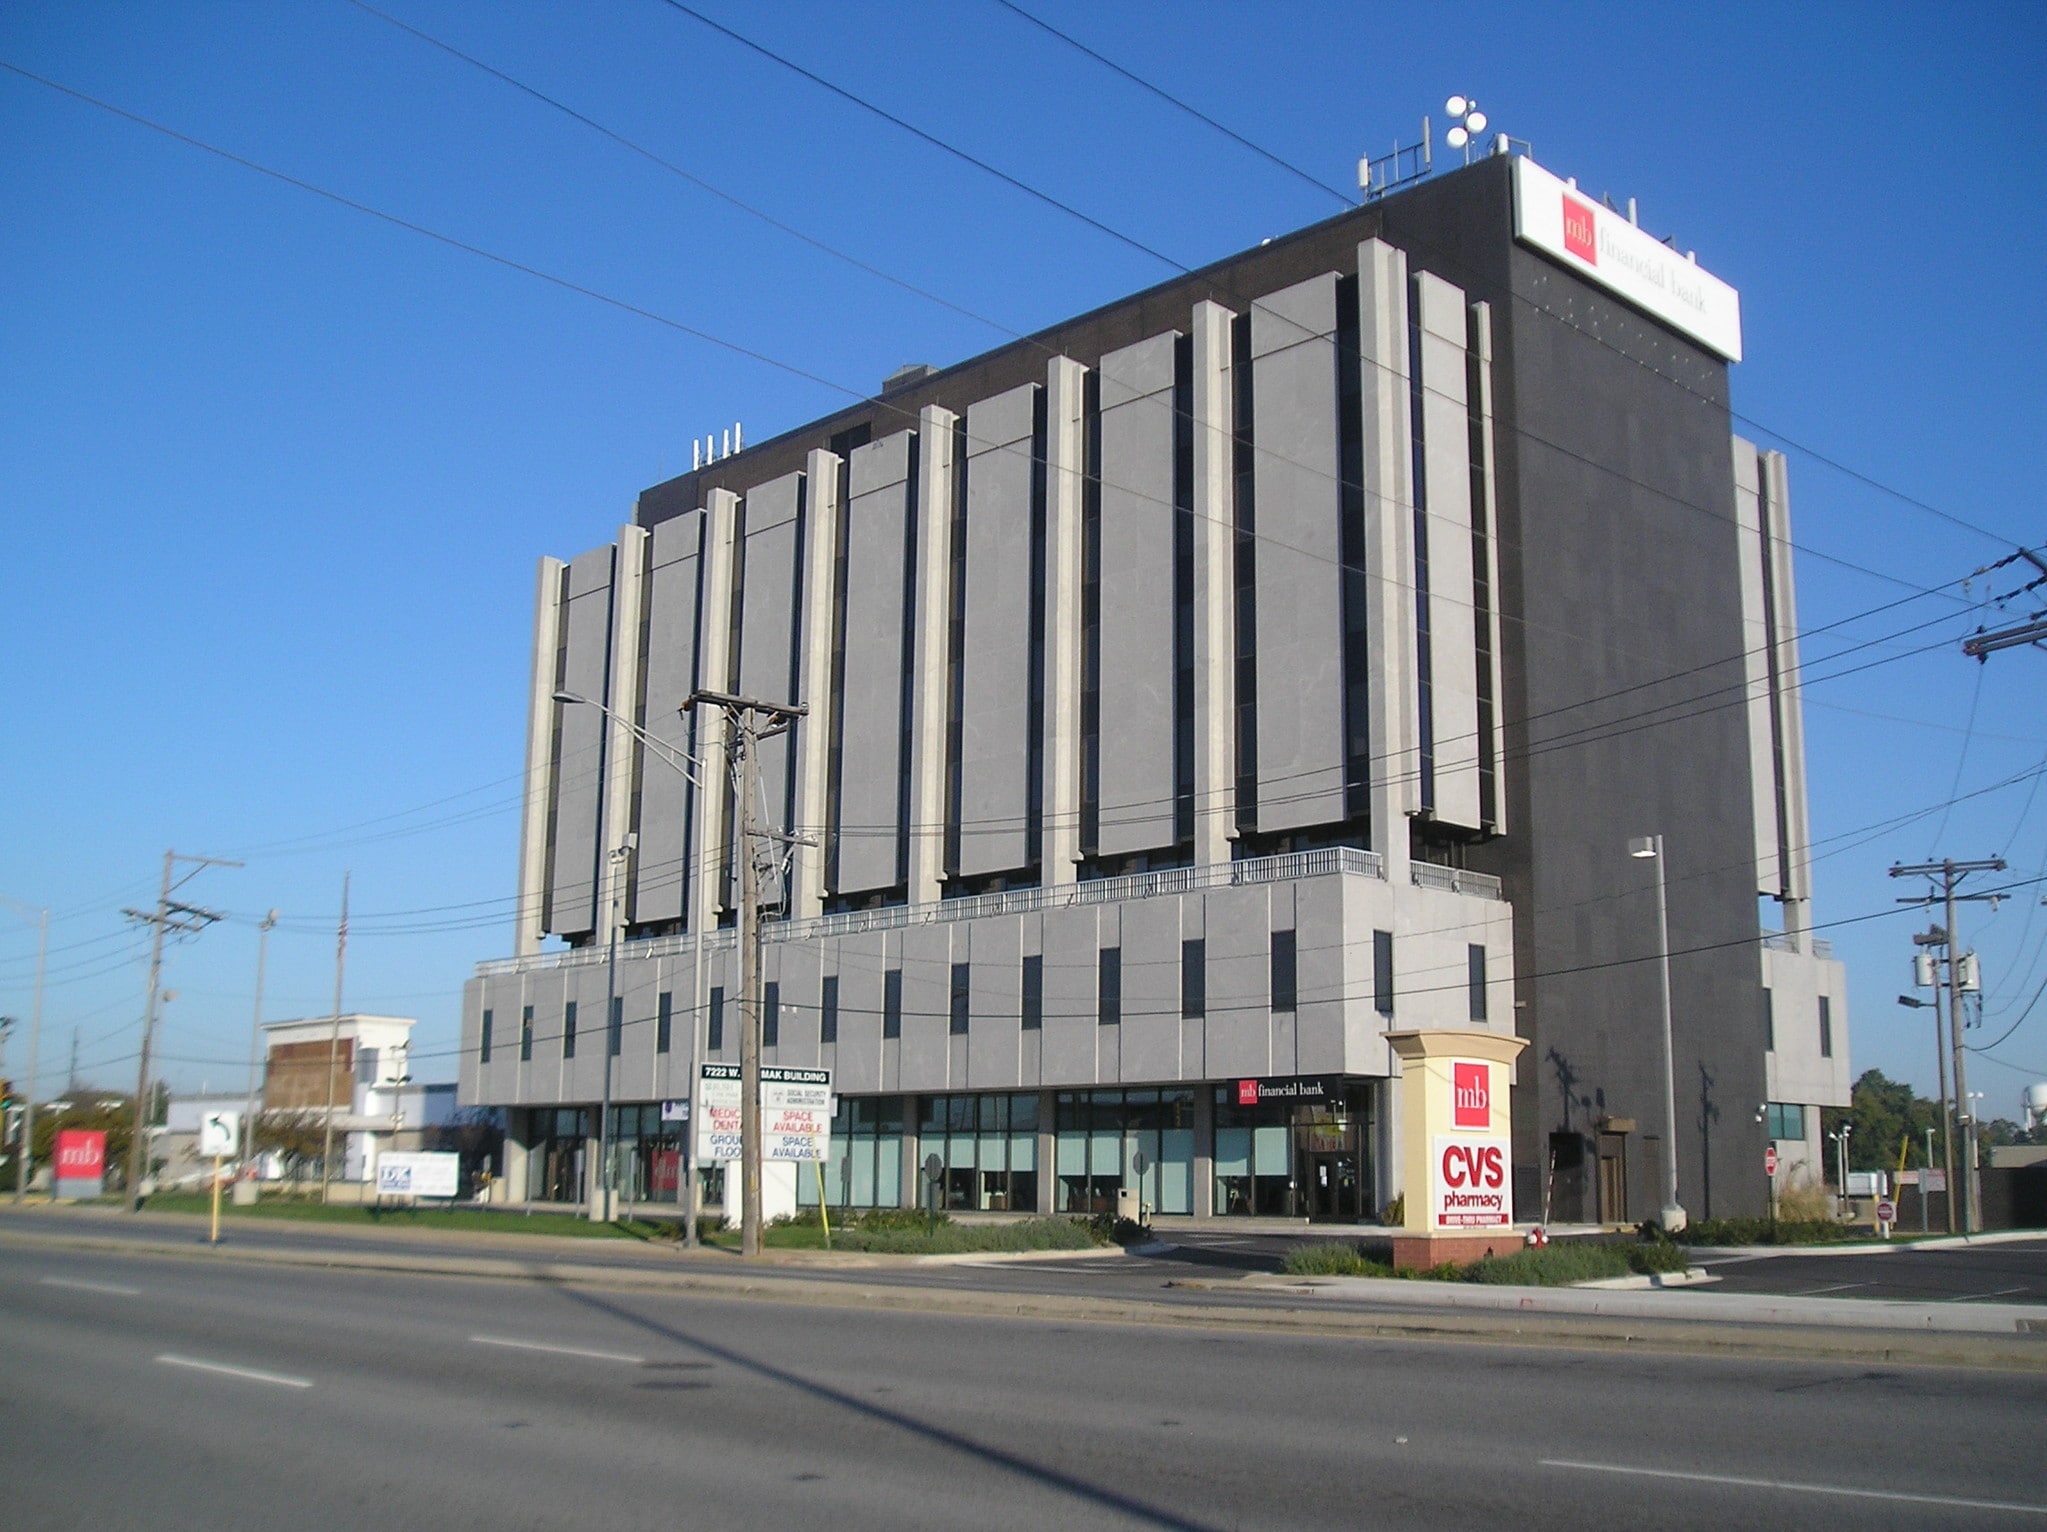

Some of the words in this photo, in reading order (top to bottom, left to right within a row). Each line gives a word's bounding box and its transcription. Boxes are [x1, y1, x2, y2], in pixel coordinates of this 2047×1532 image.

[1566, 214, 1592, 247] mb
[1600, 226, 1665, 289] financial
[705, 1067, 727, 1077] 7222
[728, 1068, 741, 1077] W.
[784, 1071, 826, 1082] BUILDING
[1240, 1085, 1256, 1097] mb
[1258, 1082, 1297, 1096] financial
[1300, 1081, 1324, 1095] bank
[1457, 1075, 1487, 1110] mb
[710, 1108, 742, 1119] MEDIC
[783, 1111, 813, 1122] SPACE
[713, 1120, 742, 1130] DENT
[773, 1122, 822, 1133] AVAILABLE
[710, 1135, 742, 1145] GROU
[783, 1136, 813, 1147] SPACE
[61, 1138, 99, 1166] mb
[714, 1146, 742, 1157] FLOO
[772, 1147, 821, 1158] AVAILABLE
[1442, 1145, 1504, 1189] CVS
[1444, 1190, 1503, 1211] pharmacy
